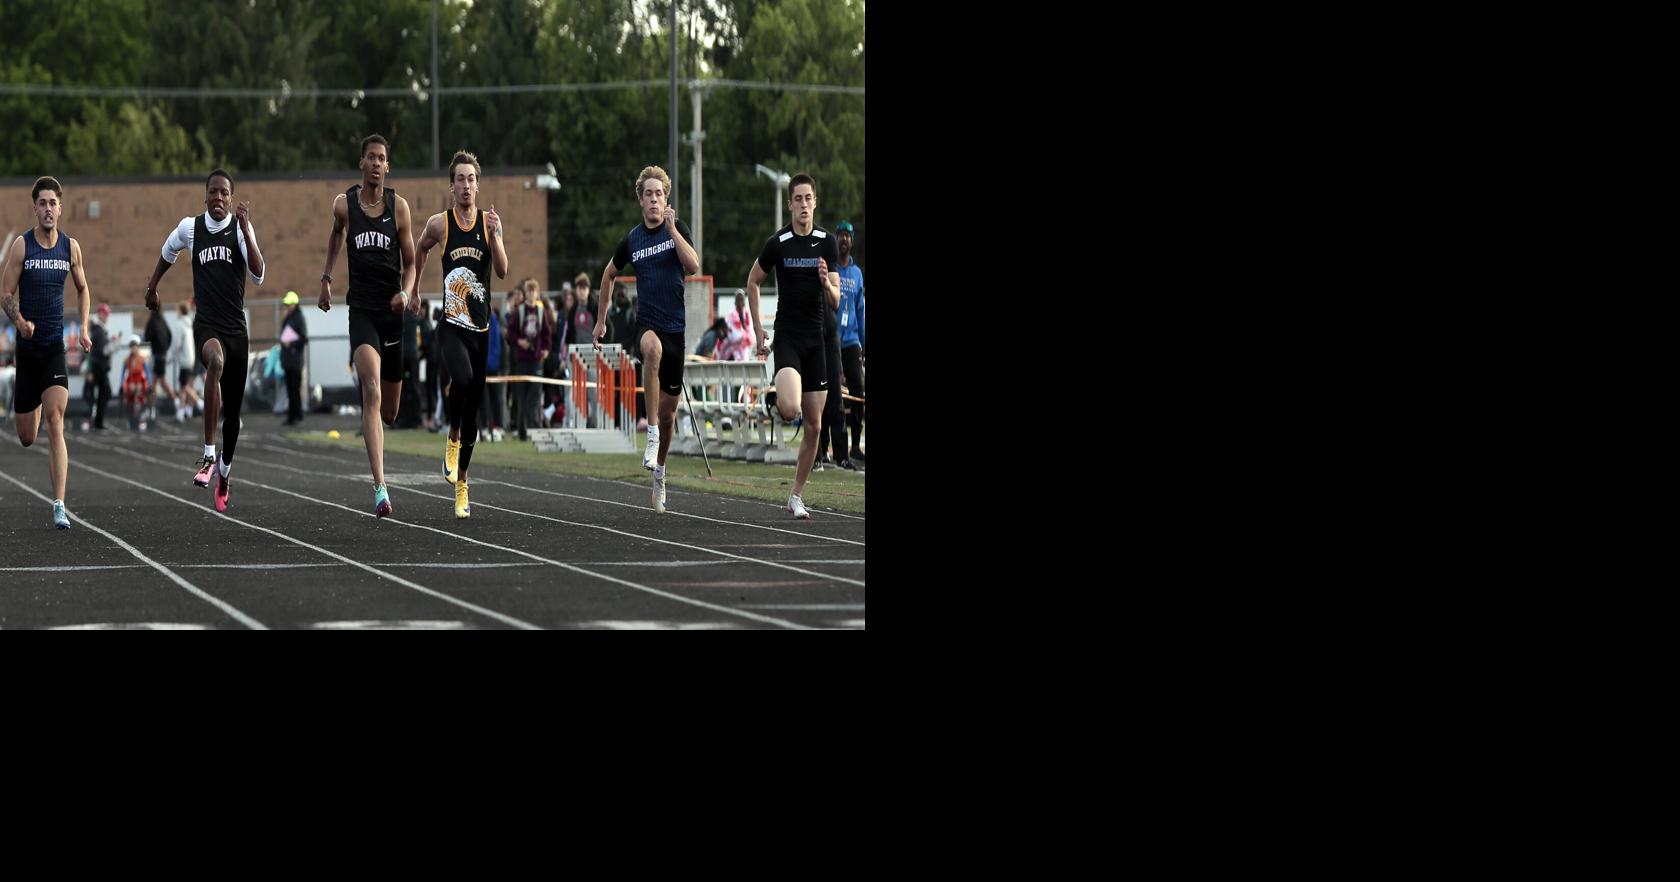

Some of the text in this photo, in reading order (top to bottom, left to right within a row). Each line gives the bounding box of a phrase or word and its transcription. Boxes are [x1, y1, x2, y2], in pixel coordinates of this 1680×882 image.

[355, 231, 391, 250] WAYNE
[199, 246, 233, 265] WAYNE
[632, 239, 675, 262] SPRINGBORO
[24, 259, 71, 271] SPRINGBORO
